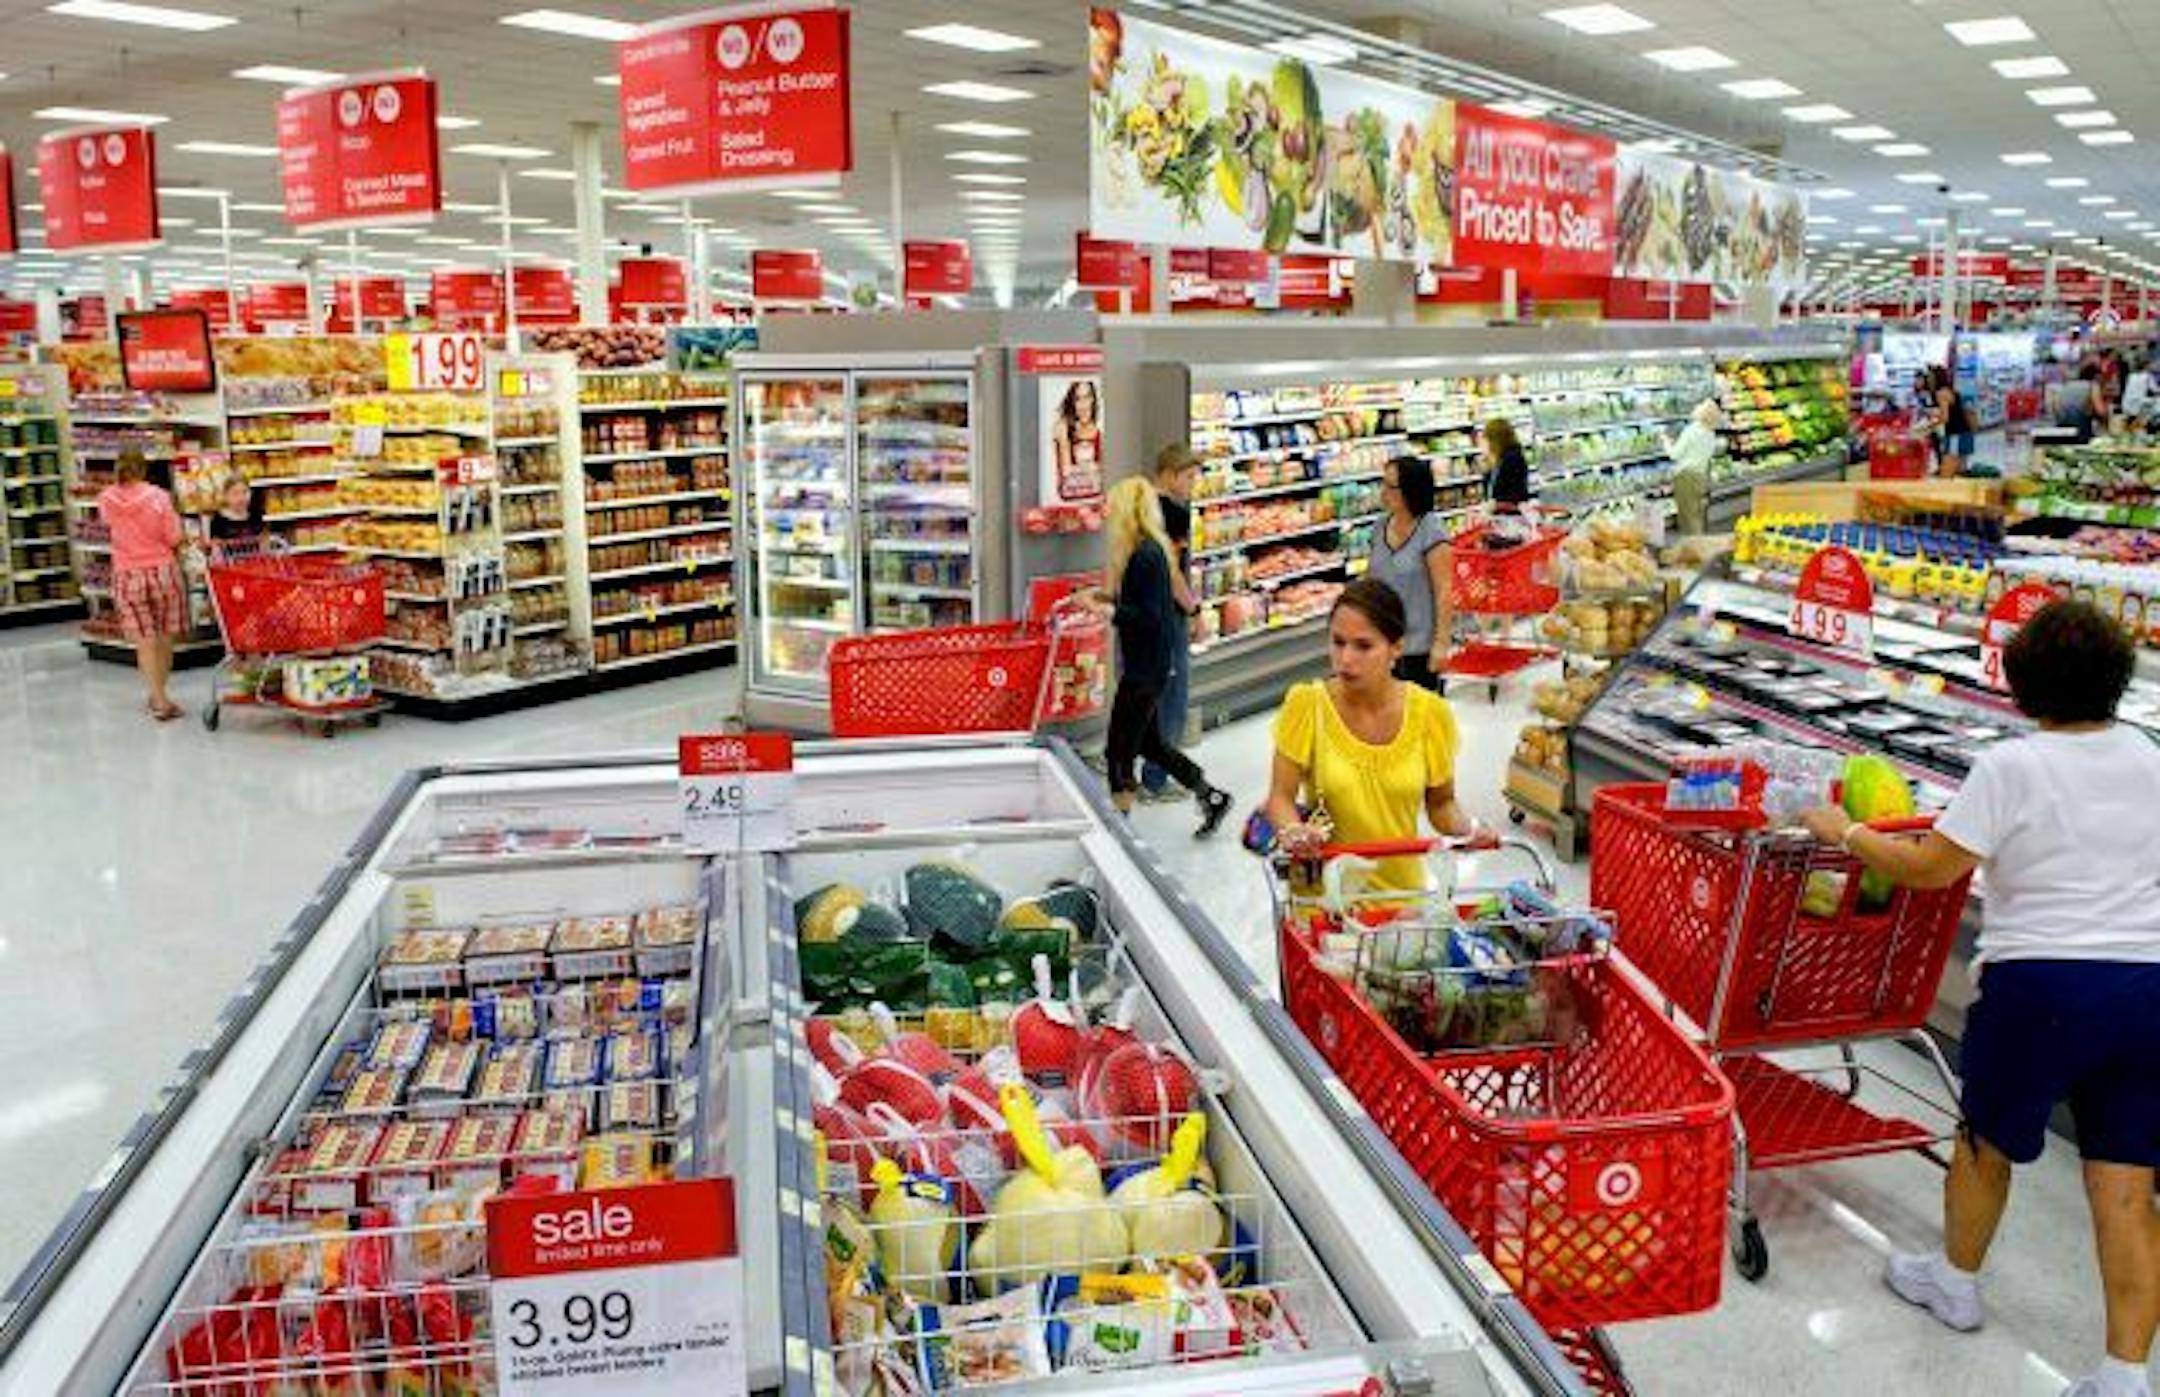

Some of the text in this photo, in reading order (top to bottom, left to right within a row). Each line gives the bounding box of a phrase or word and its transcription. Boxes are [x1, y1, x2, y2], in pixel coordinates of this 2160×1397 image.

[717, 72, 839, 97] Peanut Butter
[735, 97, 771, 116] Jelly
[720, 129, 765, 149] Salad
[721, 148, 795, 168] Dressing
[1464, 126, 1493, 180] All
[1498, 142, 1540, 195] you
[1460, 187, 1607, 251] Priced to Save.
[412, 337, 480, 386] 1.99
[700, 739, 747, 760] sale
[685, 785, 742, 811] 2.49
[532, 1196, 633, 1246] sale
[535, 1236, 665, 1264] limited time only
[509, 1291, 633, 1349] 3.99
